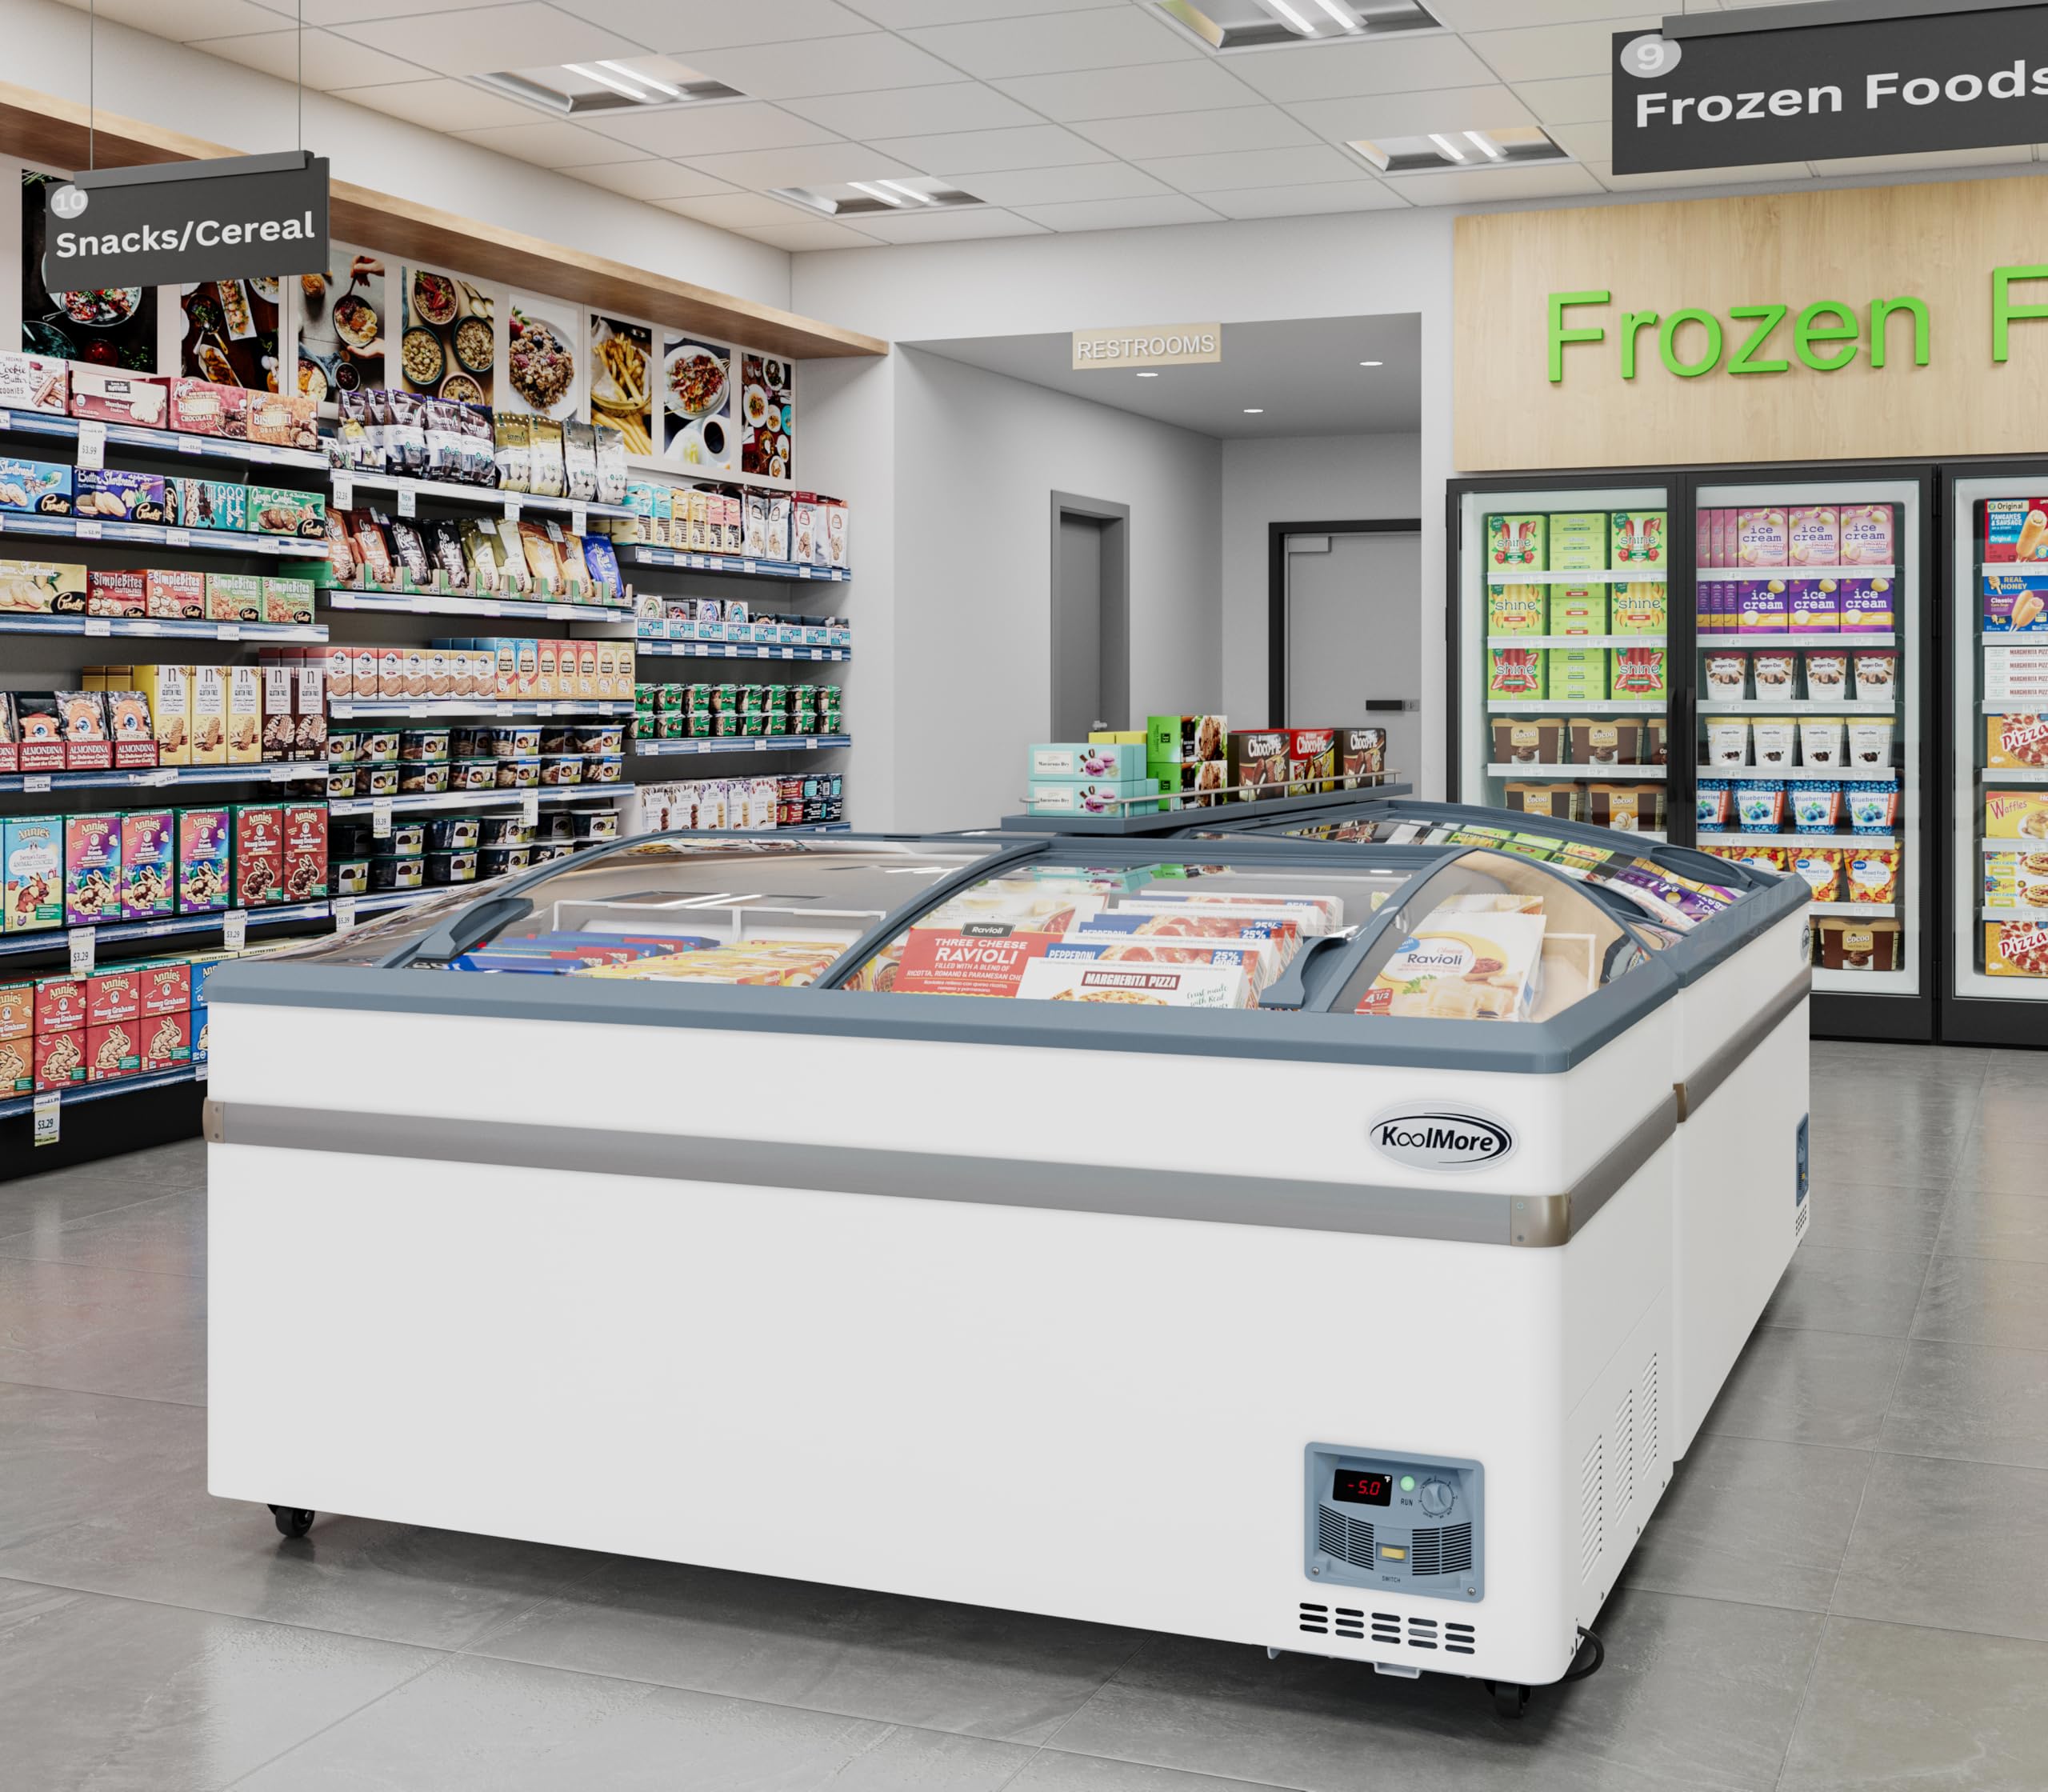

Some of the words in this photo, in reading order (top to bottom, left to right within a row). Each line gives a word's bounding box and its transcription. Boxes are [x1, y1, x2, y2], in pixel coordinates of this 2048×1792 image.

[1637, 43, 1665, 70] 9
[1637, 85, 1842, 127] Frozen
[55, 192, 86, 212] 10
[56, 211, 314, 258] Snacks/Cereal
[1549, 291, 1930, 382] Frozen
[1078, 334, 1214, 359] RESTROOMS
[82, 445, 97, 455] $3.99
[1998, 502, 2023, 510] Original
[1750, 525, 1773, 534] ice
[1802, 524, 1824, 533] ice
[1853, 523, 1876, 532] ice
[1620, 534, 1656, 546] shine
[1743, 534, 1781, 542] cream
[1846, 532, 1885, 540] cream
[1497, 537, 1531, 548] shine
[94, 573, 142, 588] SimpleBites
[153, 571, 200, 587] SimpleBites
[212, 575, 257, 590] SimpleBites
[268, 578, 310, 594] SimpleBites
[1751, 590, 1774, 600] ice
[1802, 589, 1826, 599] ice
[1854, 588, 1878, 598] ice
[1494, 599, 1536, 611] shine
[1618, 597, 1662, 609] shine
[1743, 601, 1783, 610] cream
[1794, 600, 1834, 609] cream
[1846, 599, 1887, 608] cream
[1496, 663, 1534, 674] shine
[1619, 662, 1659, 674] shine
[168, 667, 176, 682] n
[206, 668, 213, 682] n
[240, 668, 247, 682] n
[274, 670, 282, 683] n
[307, 670, 314, 684] n
[2002, 724, 2048, 750] Pizza
[22, 746, 62, 755] ALMONDINA
[70, 745, 107, 754] ALMONDINA
[1990, 797, 2027, 819] Waffles
[193, 815, 217, 828] Annie's
[249, 811, 272, 825] Annie's
[295, 810, 318, 822] Annie's
[82, 820, 109, 834] Annie's
[134, 818, 161, 832] Annie's
[18, 825, 50, 840] Annie's
[226, 930, 240, 938] $3.29
[1242, 930, 1266, 938] 25%
[935, 938, 974, 946] THREE
[978, 940, 1028, 949] CHEESE
[2000, 932, 2047, 957] Pizza
[934, 948, 1018, 964] RAVIOLI
[1049, 950, 1096, 960] PEPPERONI
[1215, 952, 1238, 960] 25%
[1407, 954, 1462, 965] Ravioli
[154, 970, 180, 984] Annie's
[968, 972, 1008, 980] PARAMESAN
[1085, 973, 1146, 986] MARGHERITA
[1148, 976, 1177, 987] PIZZA
[101, 978, 130, 992] Annie's
[50, 986, 78, 998] Annie's
[1365, 994, 1375, 1003] 4
[38, 1118, 54, 1130] $3.29
[1382, 1126, 1493, 1151] KoolMore
[1401, 1498, 1413, 1506] RUN
[1382, 1575, 1401, 1583] SWITCH
